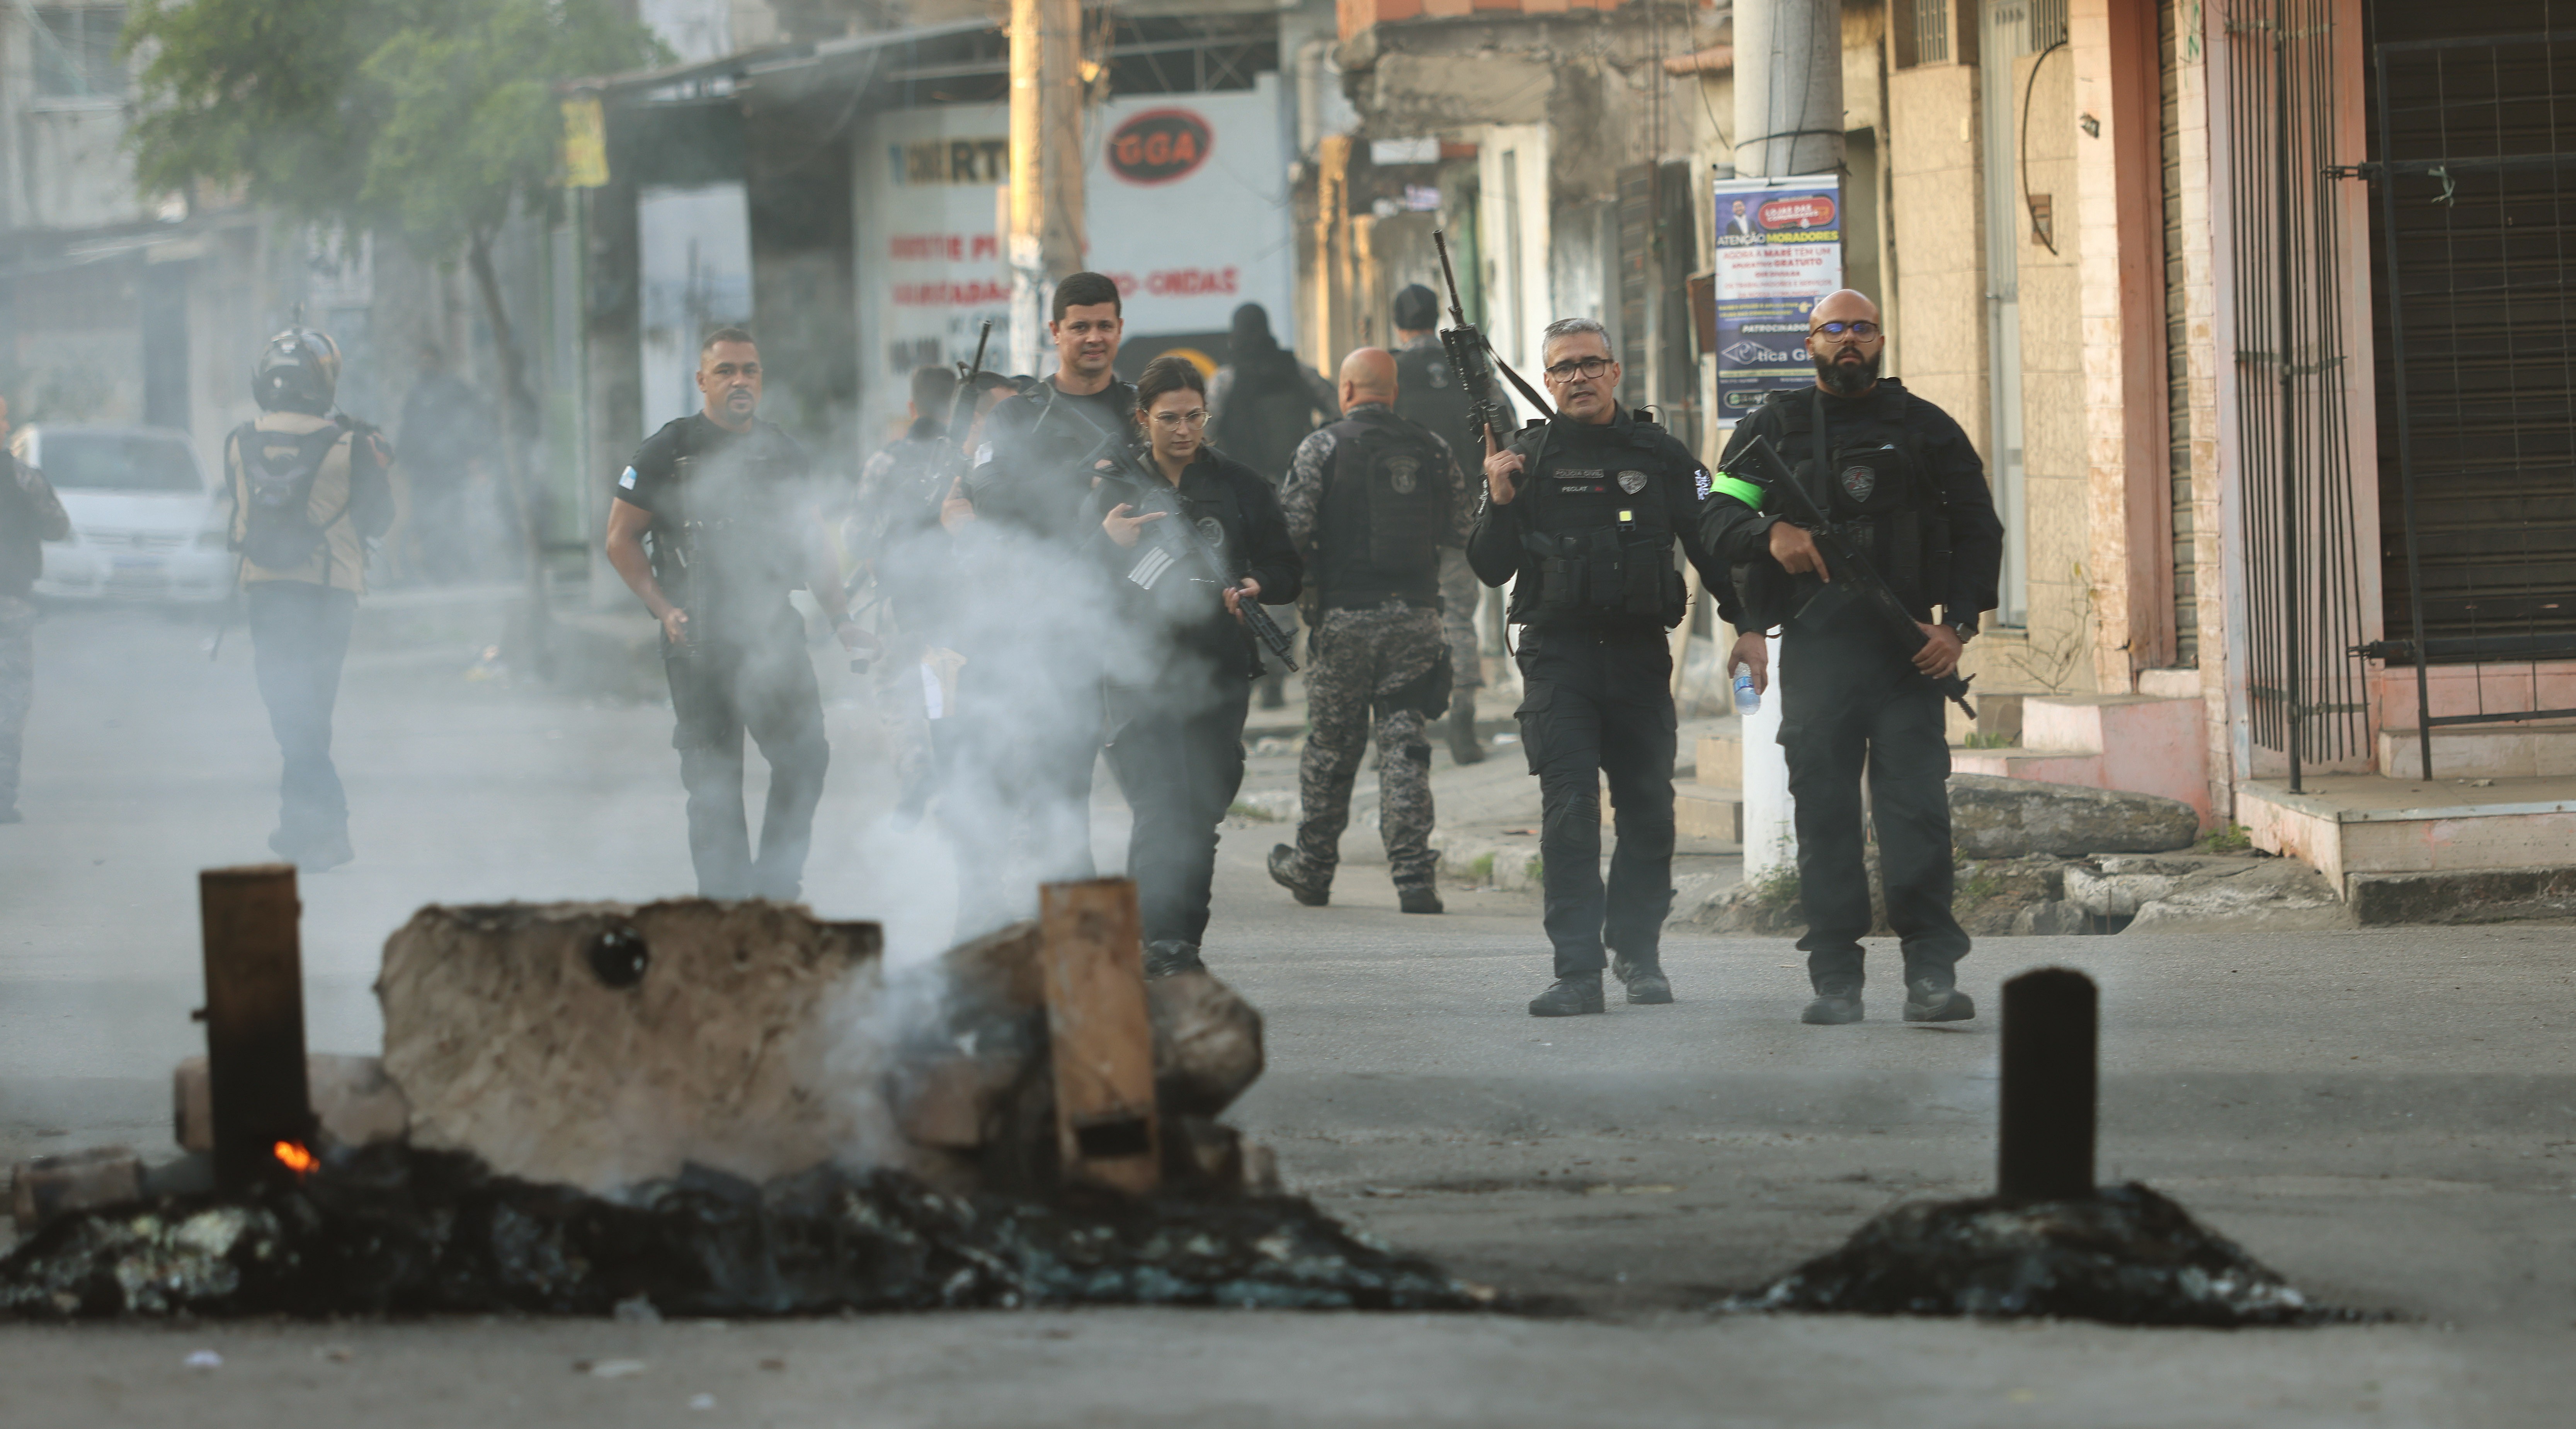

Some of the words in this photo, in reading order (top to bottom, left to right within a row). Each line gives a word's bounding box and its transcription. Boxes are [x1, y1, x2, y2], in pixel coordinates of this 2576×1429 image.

[1117, 129, 1196, 165] GGA
[1717, 232, 1766, 246] ATENÇÃO
[1767, 231, 1839, 243] MORADORES
[1764, 247, 1791, 257] MARÉ
[1773, 258, 1822, 267] GRATUITO
